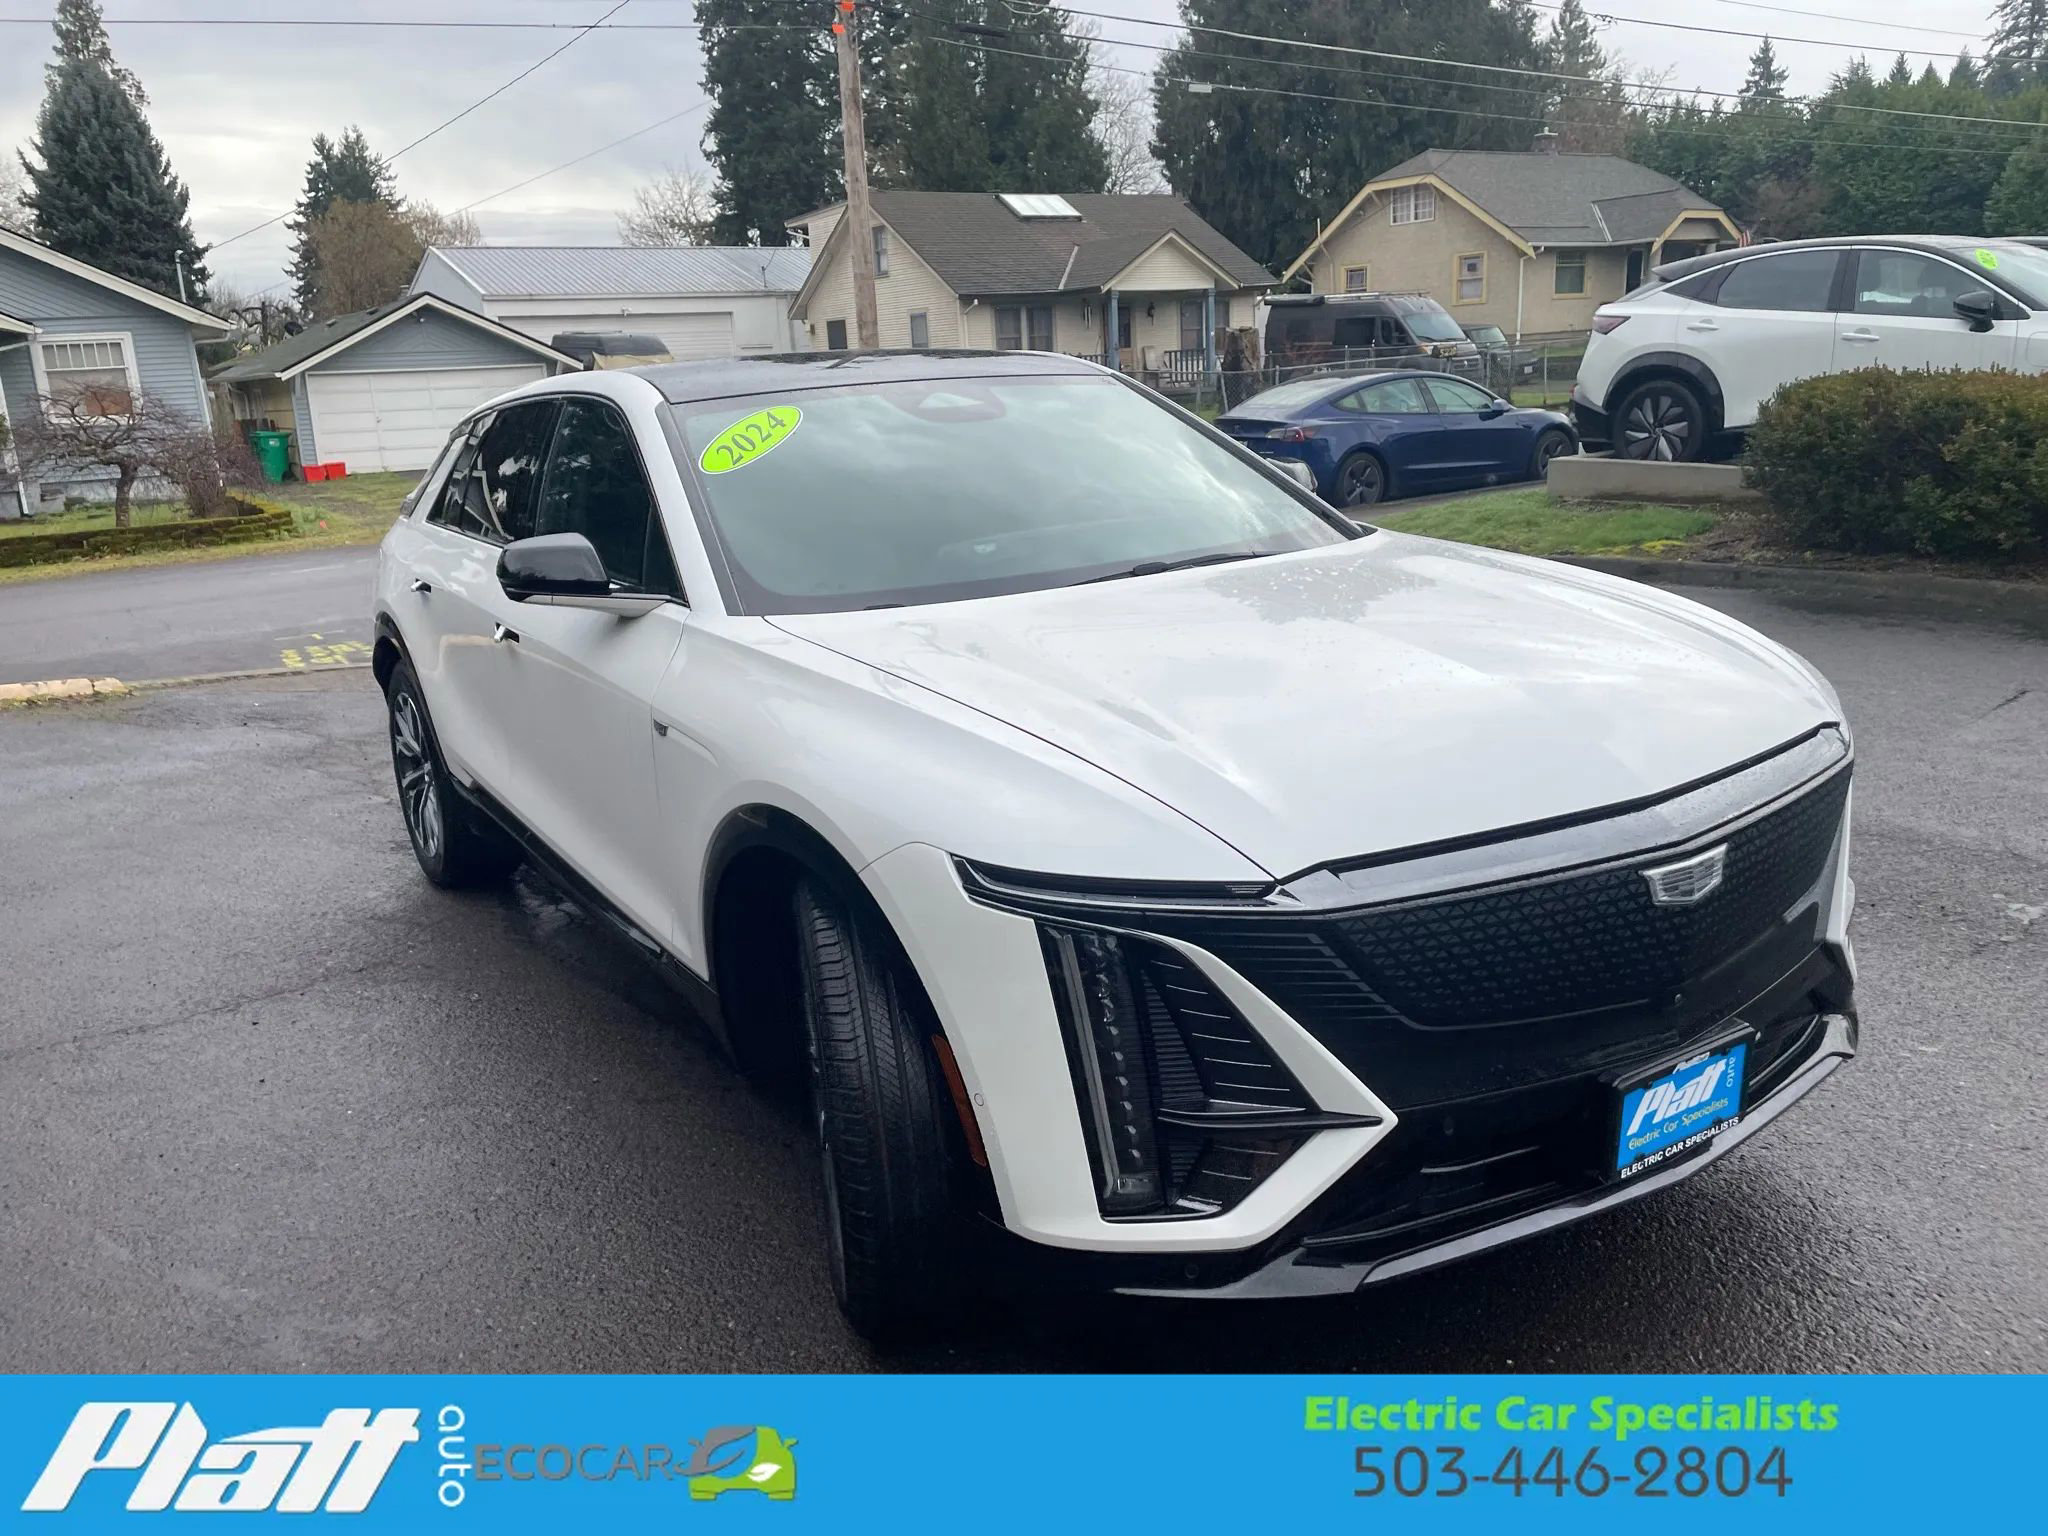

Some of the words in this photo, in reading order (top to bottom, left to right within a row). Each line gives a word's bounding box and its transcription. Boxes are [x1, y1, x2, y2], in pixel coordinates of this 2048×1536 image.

[716, 411, 786, 466] 2024
[1626, 1058, 1727, 1137] Platt
[1726, 1056, 1737, 1088] auto
[1620, 1151, 1663, 1179] ELECTRIC
[1665, 1140, 1684, 1157] CAR
[1685, 1116, 1739, 1148] SPECIALISTS
[1628, 1128, 1661, 1150] Electric
[1663, 1120, 1679, 1133] Car
[1681, 1098, 1729, 1126] Specialists
